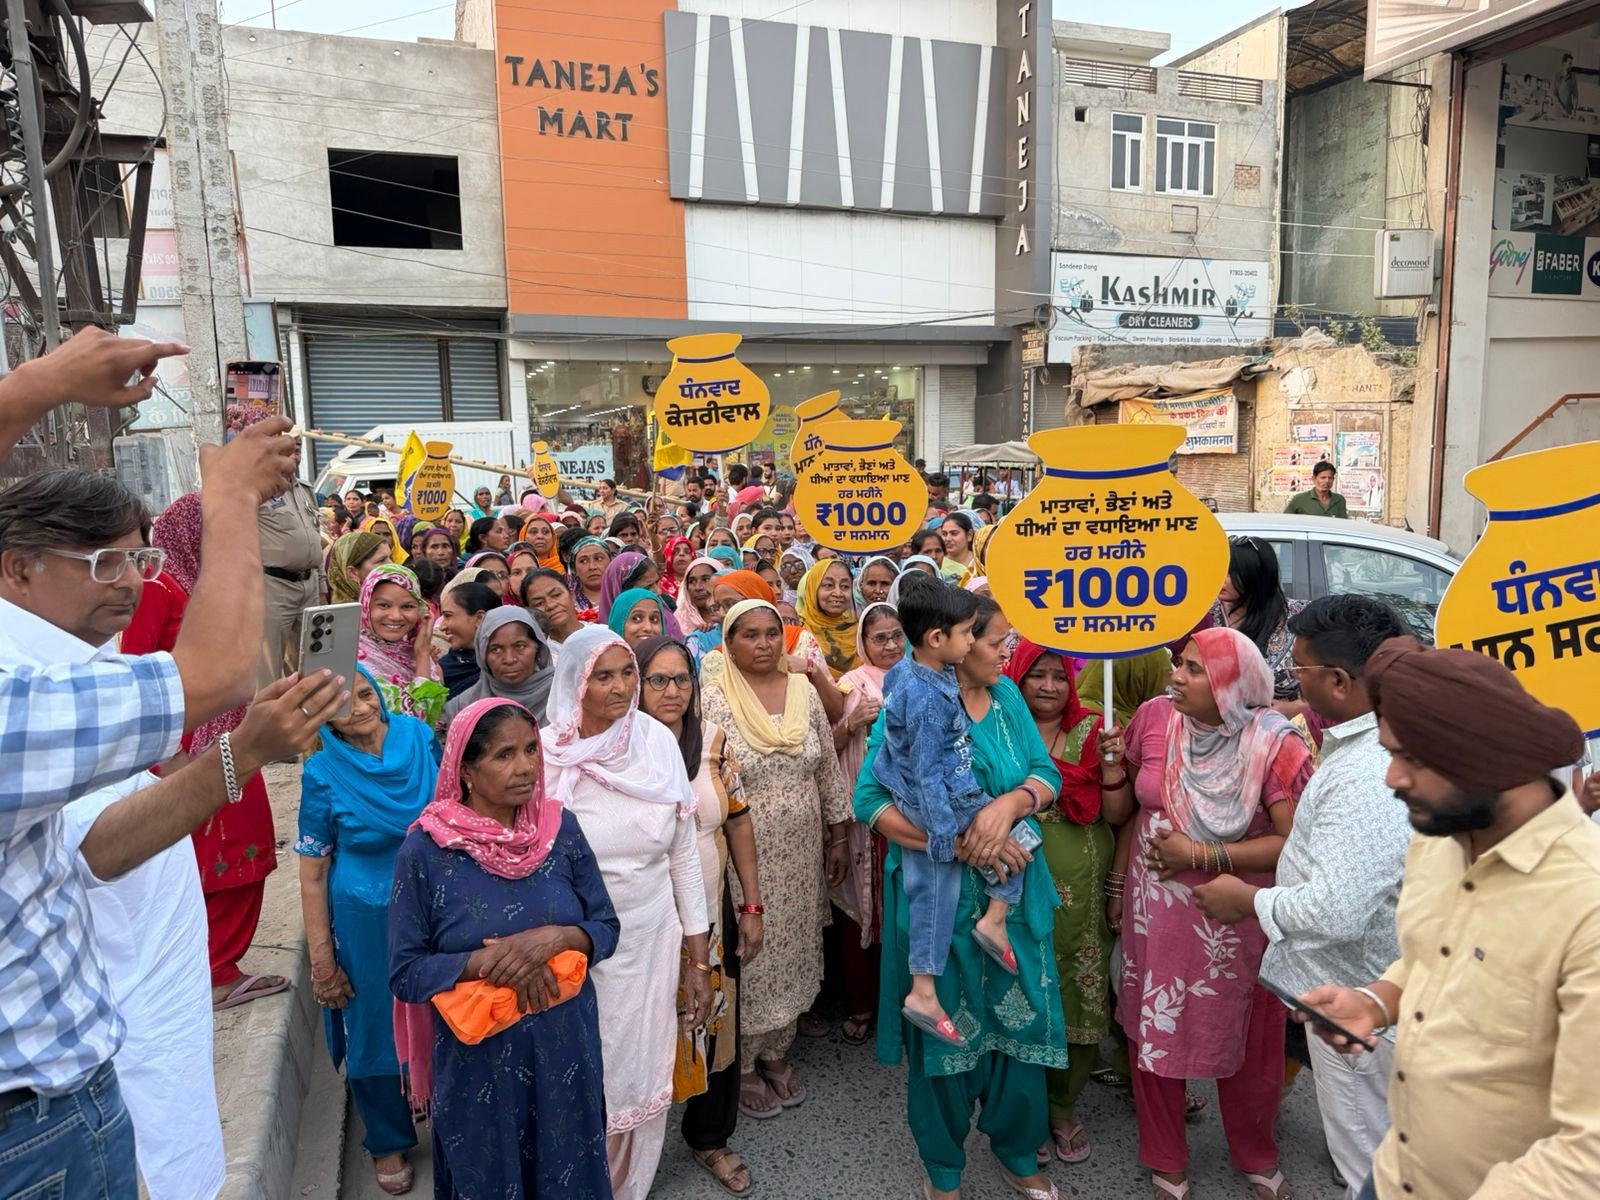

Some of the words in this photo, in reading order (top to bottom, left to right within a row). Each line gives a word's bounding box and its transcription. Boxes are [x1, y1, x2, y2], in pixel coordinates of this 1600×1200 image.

[504, 55, 659, 97] TANEJA'S
[537, 106, 633, 142] MART
[1015, 2, 1032, 256] TANEJA
[1059, 262, 1082, 271] Sandeep
[1391, 256, 1430, 267] decowood
[1545, 252, 1580, 271] FABER
[1128, 316, 1146, 327] DRY
[1149, 316, 1194, 328] CLEANERS
[678, 377, 741, 399] ਧੰਨਵਾਦ
[665, 400, 761, 427] ਕੇਜਰੀਵਾਲ
[823, 459, 856, 472] ਮਾਤਾਵਾਂ,
[879, 458, 896, 470] ਅਤੇ
[810, 473, 833, 484] ਧੀਆਂ
[836, 475, 846, 484] ਦਾ
[892, 473, 910, 483] ਮਾਣ
[417, 489, 447, 505] ₹1000
[838, 489, 853, 499] ਹਰ
[856, 486, 883, 498] ਮਹੀਨੇ
[1040, 493, 1100, 514] ਮਾਤਾਵਾਂ,
[1105, 491, 1137, 512] ਭੈਣਾਂ
[1141, 490, 1173, 510] ਅਤੇ
[816, 501, 906, 526] ₹1000
[833, 530, 846, 541] ਦਾ
[850, 530, 890, 541] ਸਨਮਾਨ
[1015, 517, 1057, 537] ਧੀਆਂ
[1062, 521, 1080, 535] ਦਾ
[1086, 514, 1160, 535] ਵਧਾਇਆ
[1165, 516, 1198, 531] ਮਾਣ
[1064, 546, 1093, 561] ਹਰ
[1098, 539, 1146, 559] ਮਹੀਨੇ
[1024, 565, 1188, 609] ₹1000
[1054, 616, 1077, 633] ਦਾ
[1083, 614, 1156, 632] ਸਨਮਾਨ
